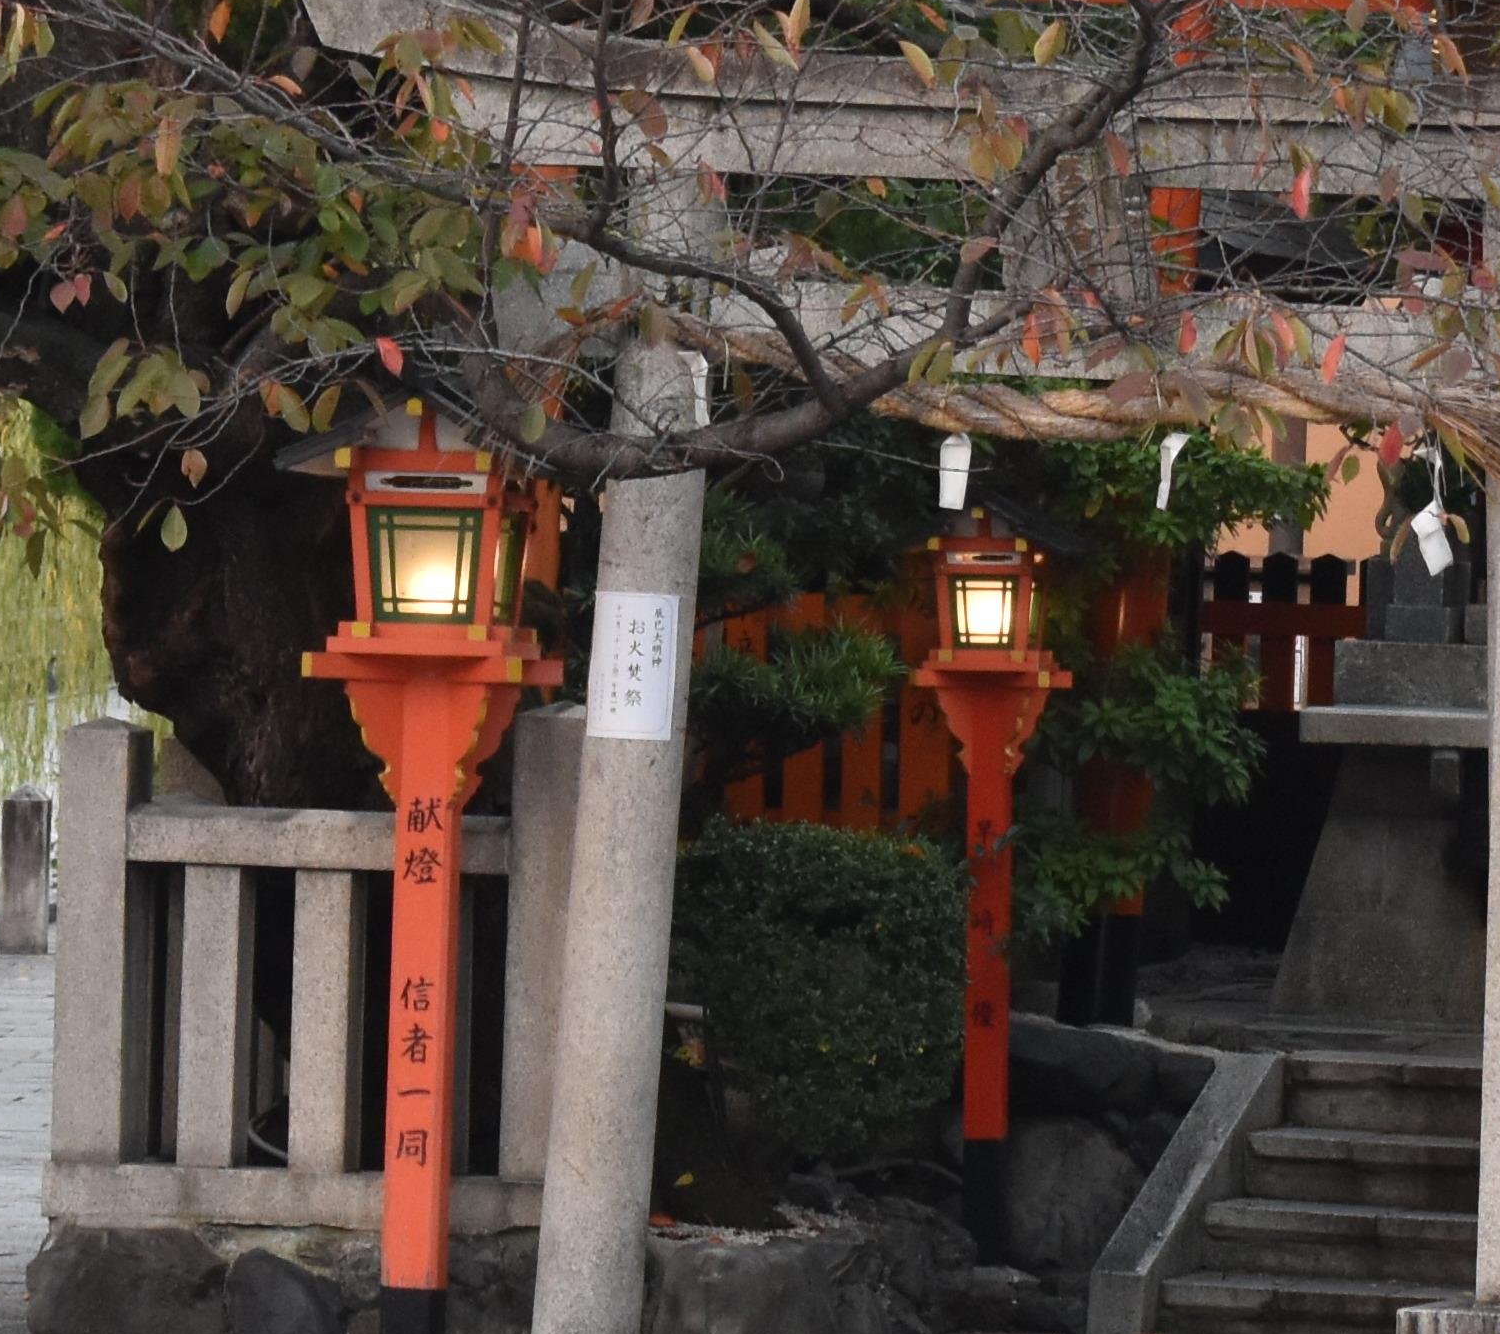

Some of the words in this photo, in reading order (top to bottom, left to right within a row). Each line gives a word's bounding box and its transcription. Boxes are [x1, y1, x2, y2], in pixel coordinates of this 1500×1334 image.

[402, 797, 444, 884] 献燈
[396, 975, 434, 1169] 信者一同
